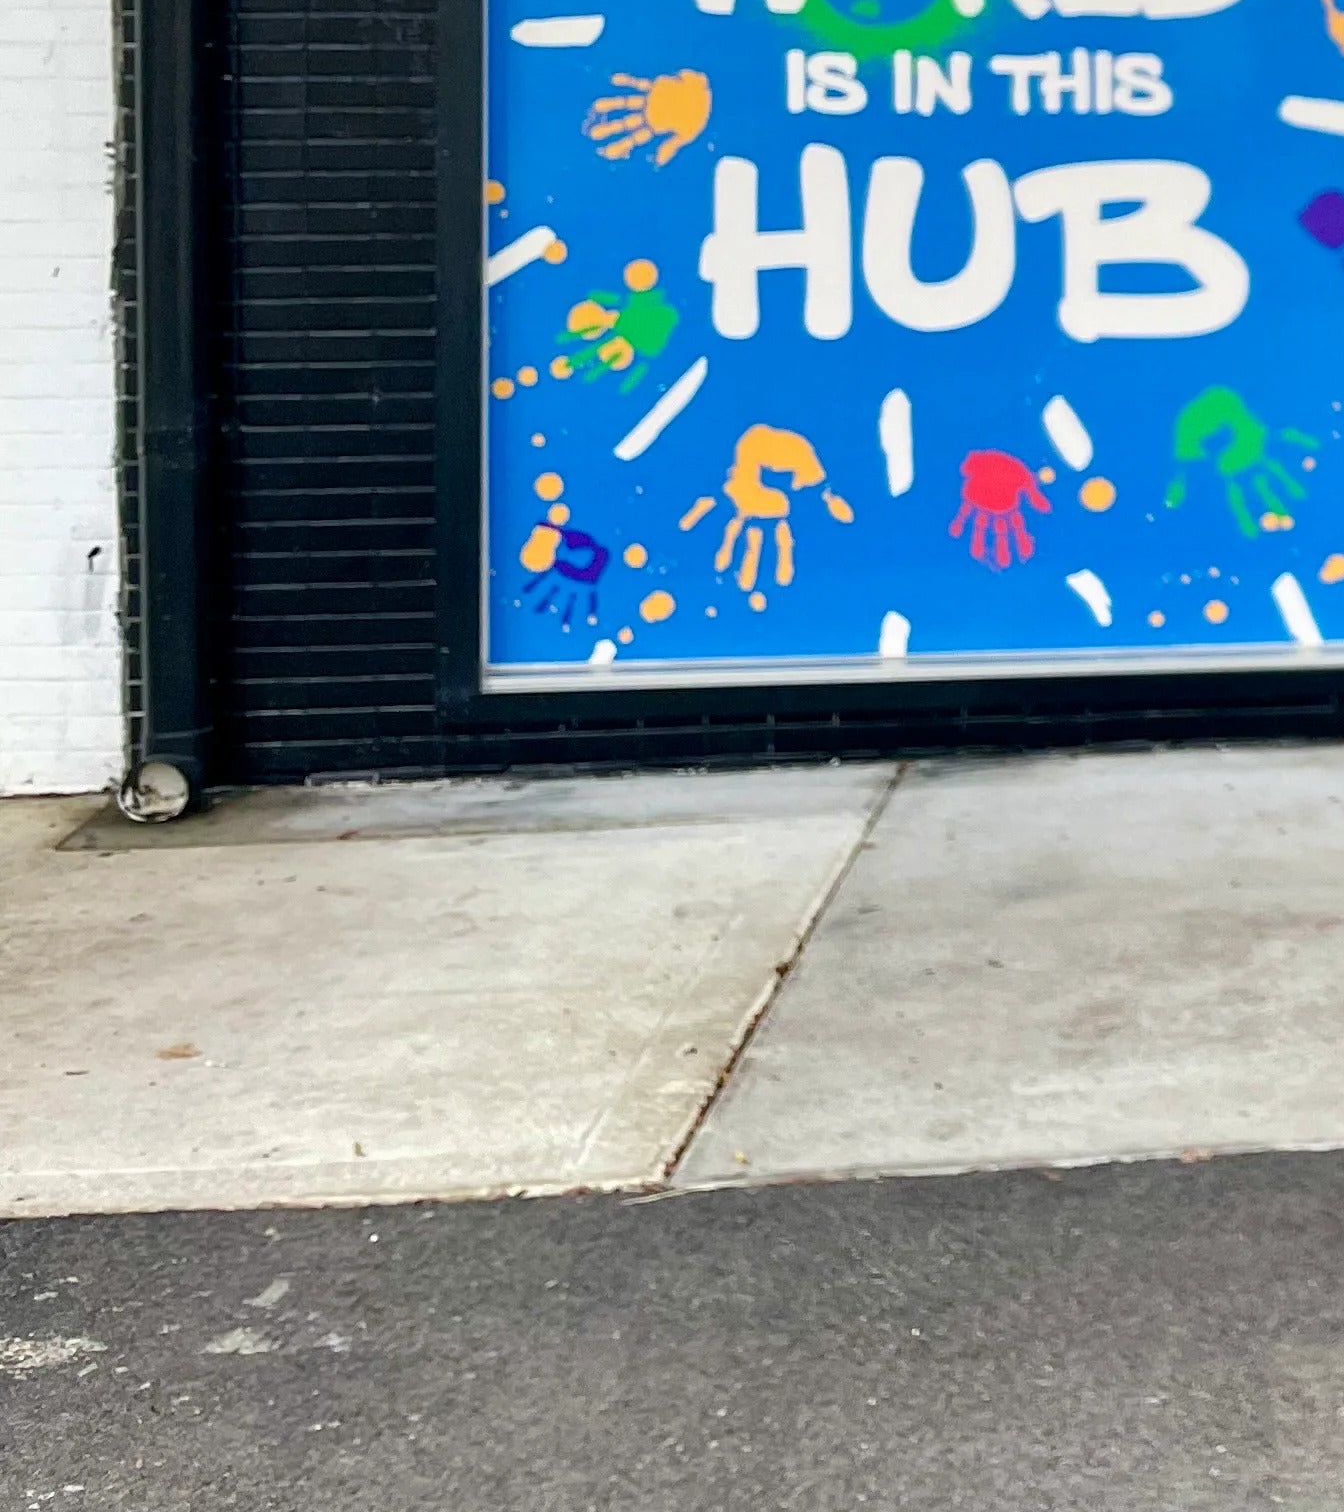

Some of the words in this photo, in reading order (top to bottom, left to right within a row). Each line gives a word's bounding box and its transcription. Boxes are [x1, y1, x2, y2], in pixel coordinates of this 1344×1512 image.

[786, 49, 867, 115] IS
[893, 50, 971, 116] IN
[990, 48, 1172, 115] THIS
[700, 143, 1250, 343] HUB
